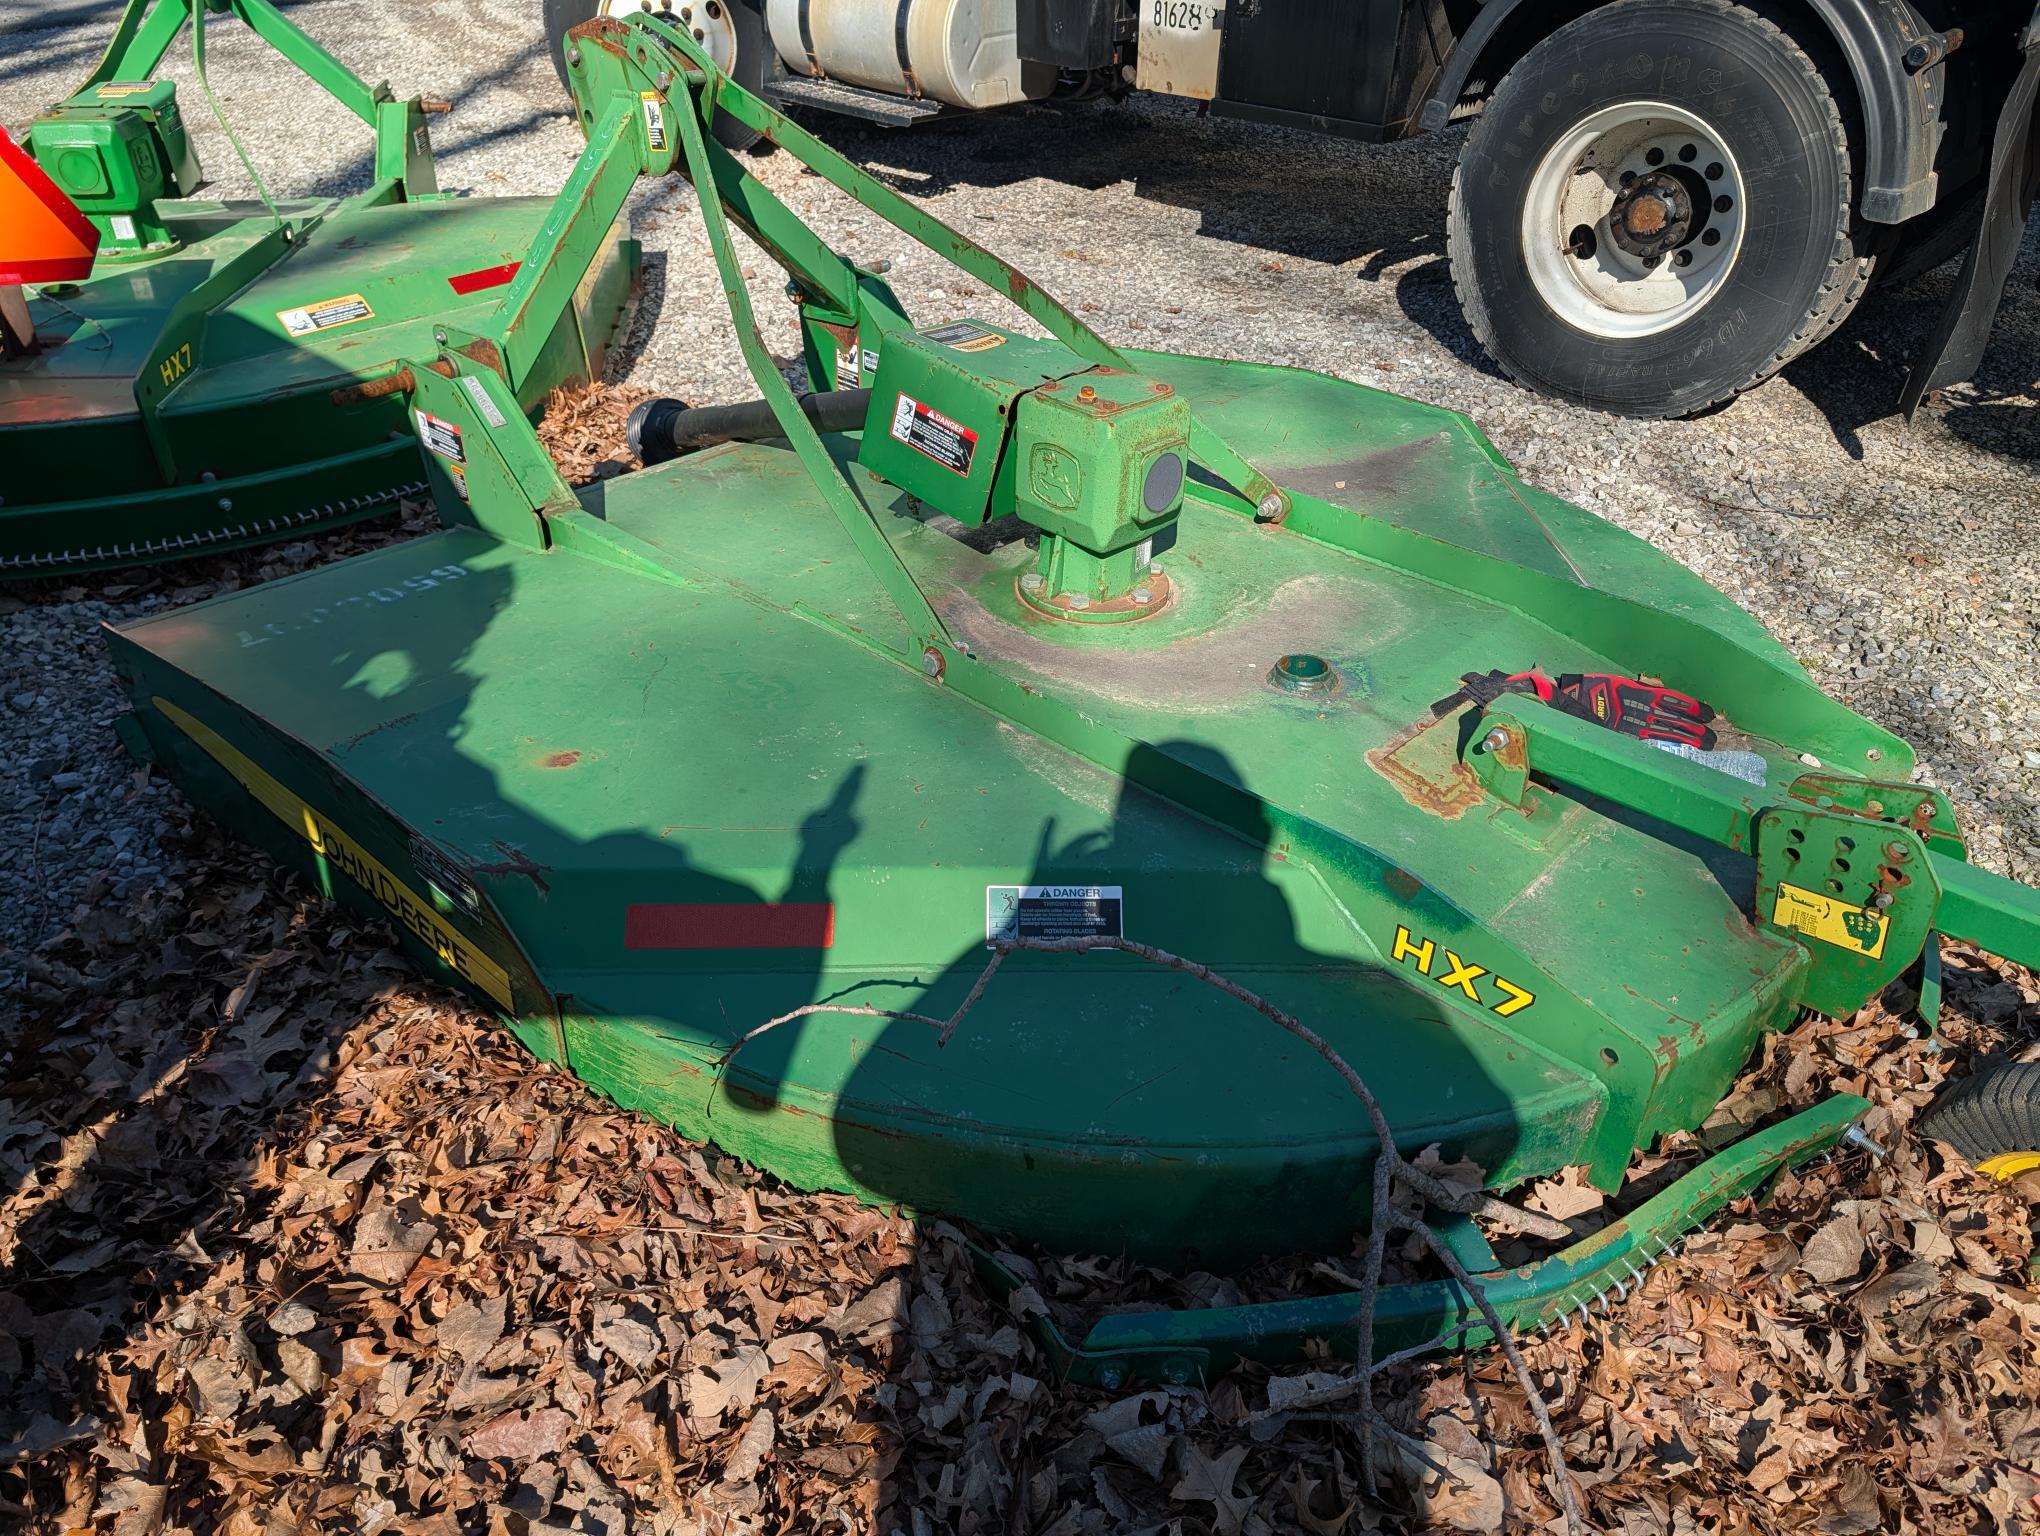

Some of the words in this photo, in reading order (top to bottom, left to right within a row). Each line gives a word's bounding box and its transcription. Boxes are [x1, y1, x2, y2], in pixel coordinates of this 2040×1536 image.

[160, 342, 191, 387] HX7
[934, 412, 965, 434] DANGER
[1597, 693, 1605, 720] ARDY
[312, 820, 376, 894] JOHN
[379, 874, 472, 979] DEERE
[1053, 888, 1101, 898] DANGER
[1391, 923, 1537, 1019] HX7
